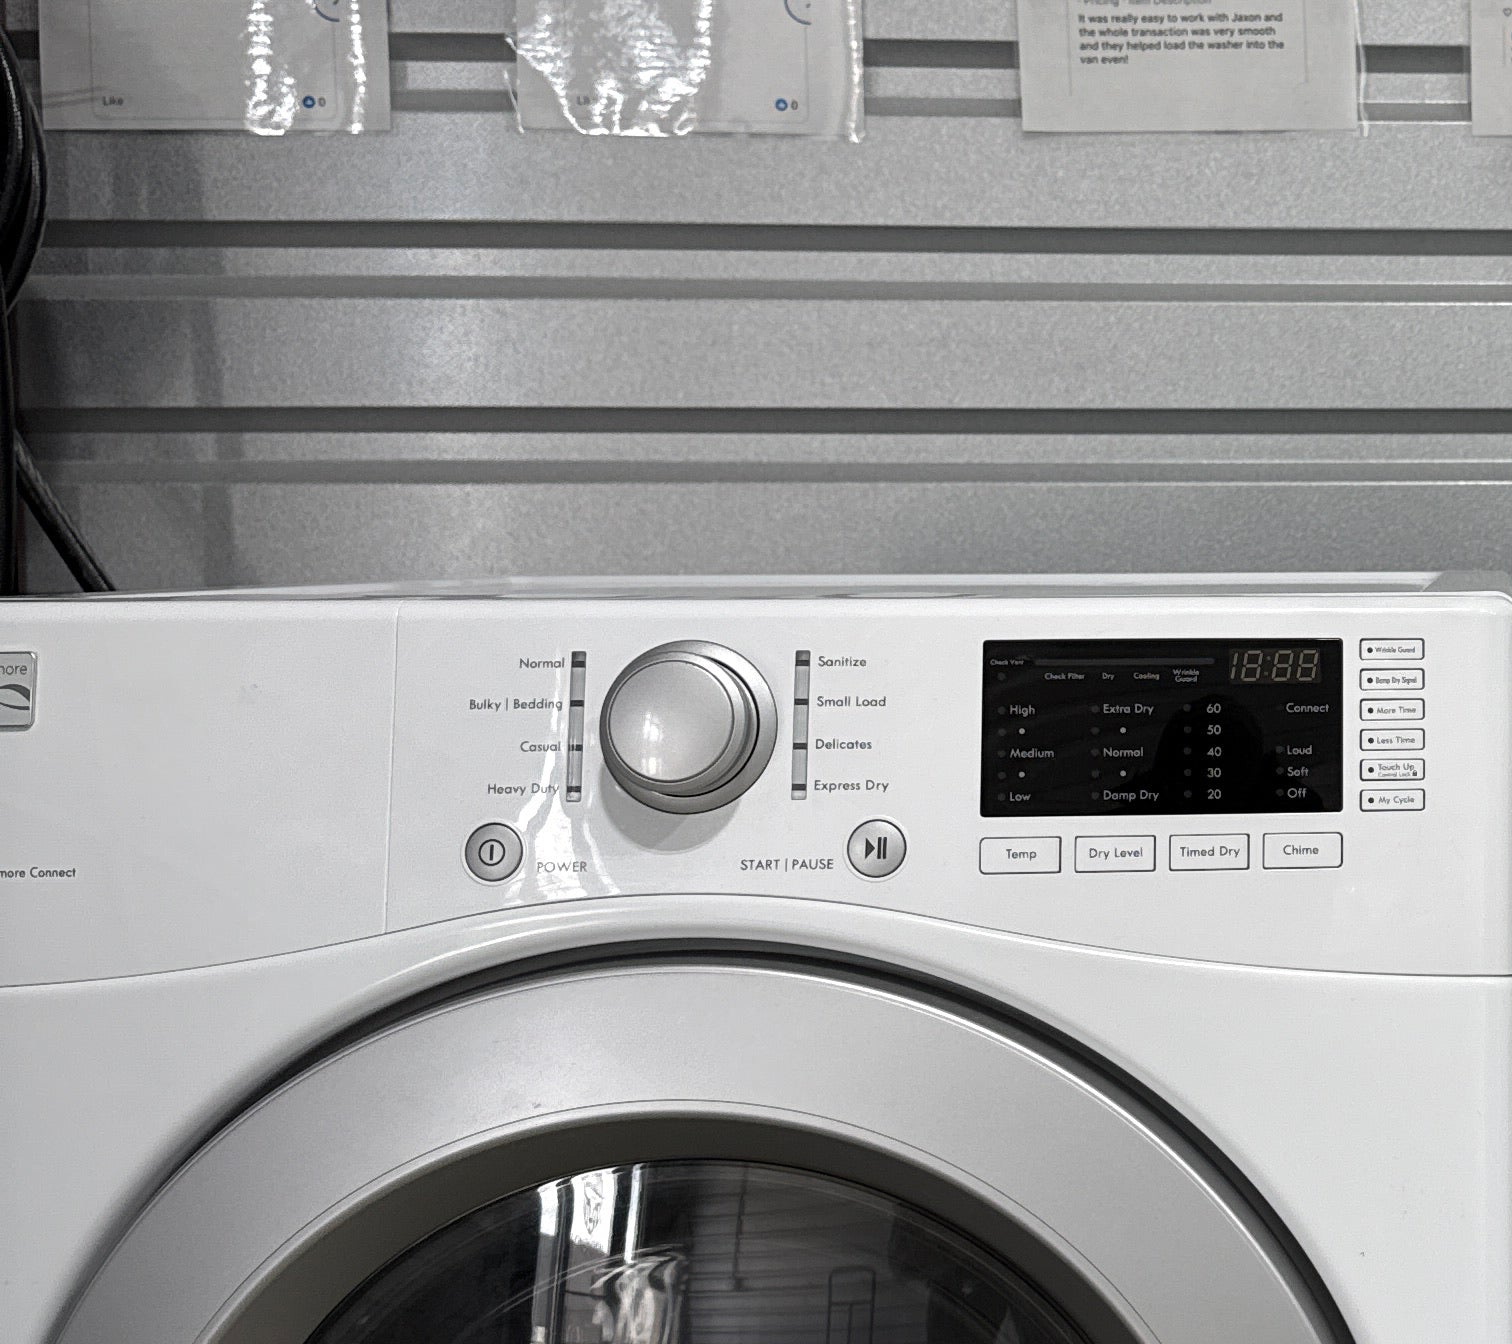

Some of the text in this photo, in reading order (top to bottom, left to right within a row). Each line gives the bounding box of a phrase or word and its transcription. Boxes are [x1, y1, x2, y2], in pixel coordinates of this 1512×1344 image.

[518, 656, 565, 669] Normal
[817, 655, 866, 668] Sanitize
[469, 697, 562, 712] Bulky Bedding
[816, 695, 886, 707] Small Load
[1009, 704, 1035, 717] High
[1102, 703, 1154, 715] Extra Dry
[1206, 702, 1221, 714] 60
[1285, 702, 1329, 713] Connect
[1206, 724, 1221, 735] 50
[519, 740, 560, 752] Casual
[815, 737, 872, 750] Delicates
[1374, 735, 1415, 745] Less Time
[1009, 747, 1054, 758] Medium
[1103, 746, 1143, 758] Normal
[1206, 746, 1222, 757] 40
[1286, 744, 1312, 755] Loud
[1206, 767, 1221, 778] 30
[1287, 765, 1308, 777] Soft
[487, 782, 559, 796] Heavy Duty
[814, 779, 889, 793] Express Dry
[1009, 791, 1031, 802] Low
[1103, 789, 1159, 803] Damp Dry
[1207, 788, 1221, 800] 20
[1286, 787, 1306, 798] Off
[1378, 795, 1415, 805] My Cycle
[1005, 847, 1037, 862] Temp
[1088, 846, 1143, 861] Dry Level
[1179, 845, 1240, 858] Timed Dry
[1282, 844, 1319, 856] Chime
[536, 860, 587, 873] POWER
[740, 858, 834, 871] START PAUSE
[0, 865, 76, 878] more Connect
